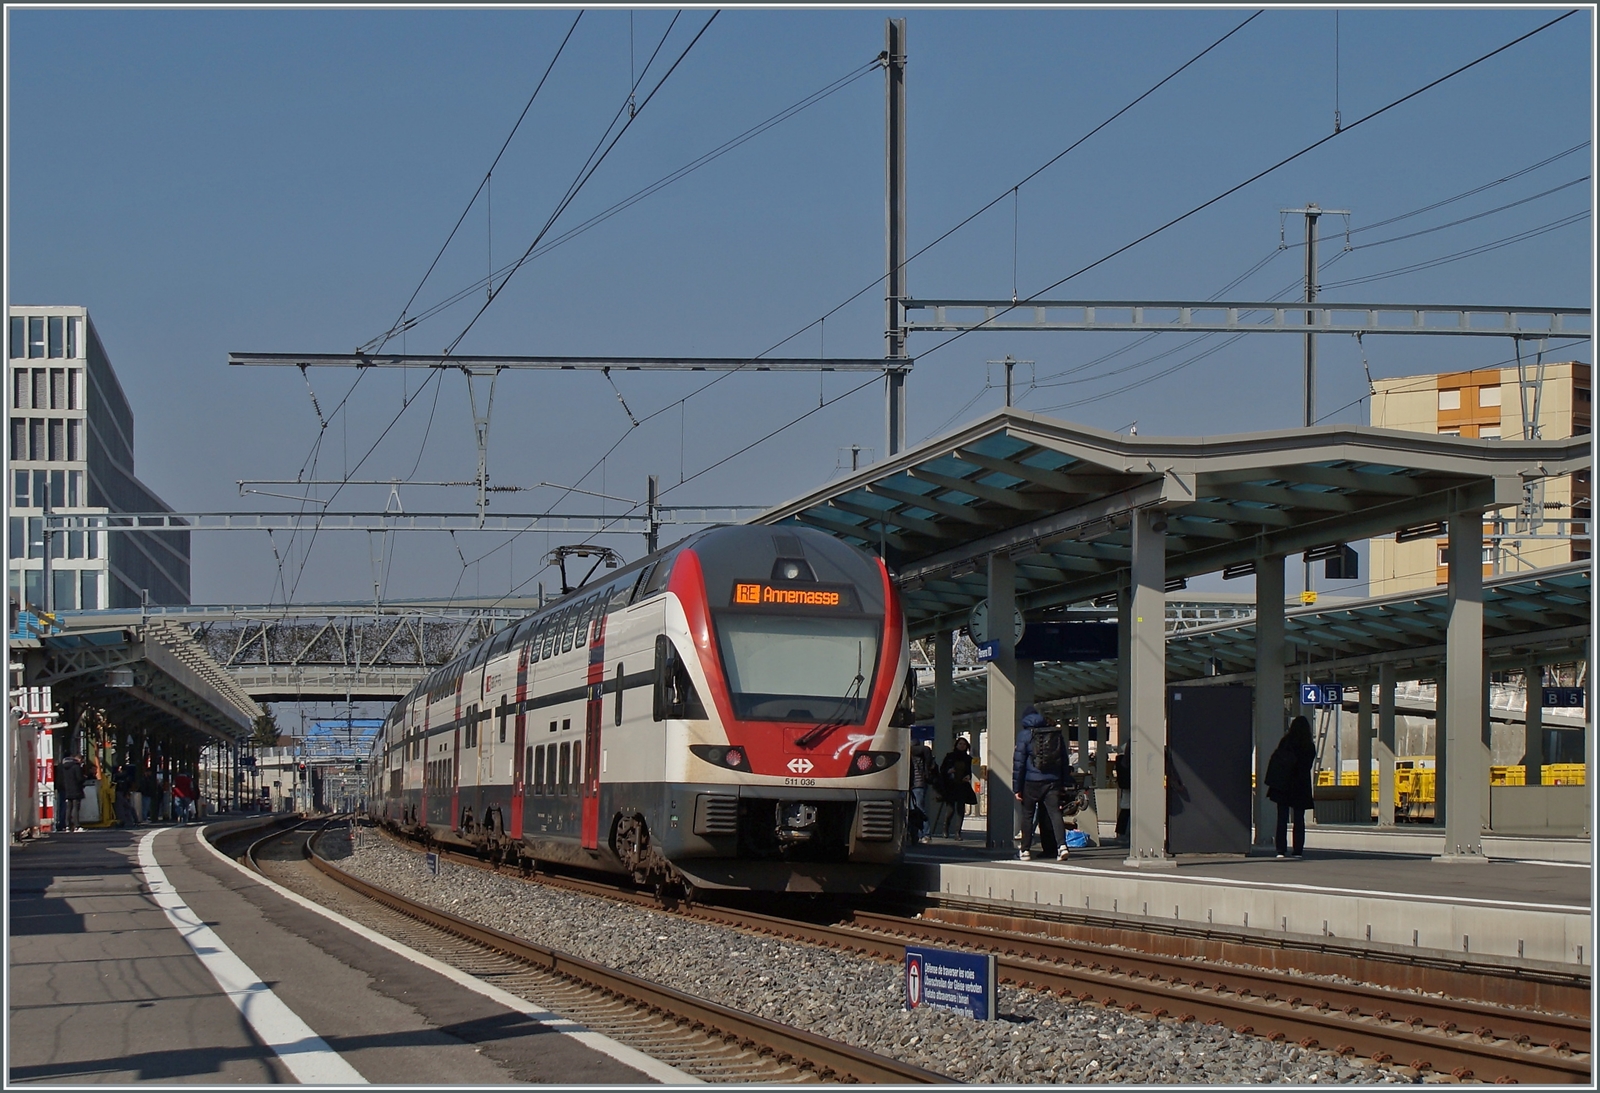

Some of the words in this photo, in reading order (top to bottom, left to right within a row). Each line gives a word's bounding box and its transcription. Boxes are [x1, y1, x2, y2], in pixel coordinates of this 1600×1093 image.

[740, 585, 757, 601] RE
[764, 586, 839, 605] Annemasse
[1307, 690, 1316, 701] 4
[1328, 690, 1338, 701] B
[1548, 693, 1558, 704] B
[1569, 693, 1578, 704] 5
[943, 965, 958, 977] traverser
[965, 968, 975, 979] voies
[954, 979, 965, 991] Gleise
[965, 982, 982, 993] verboten
